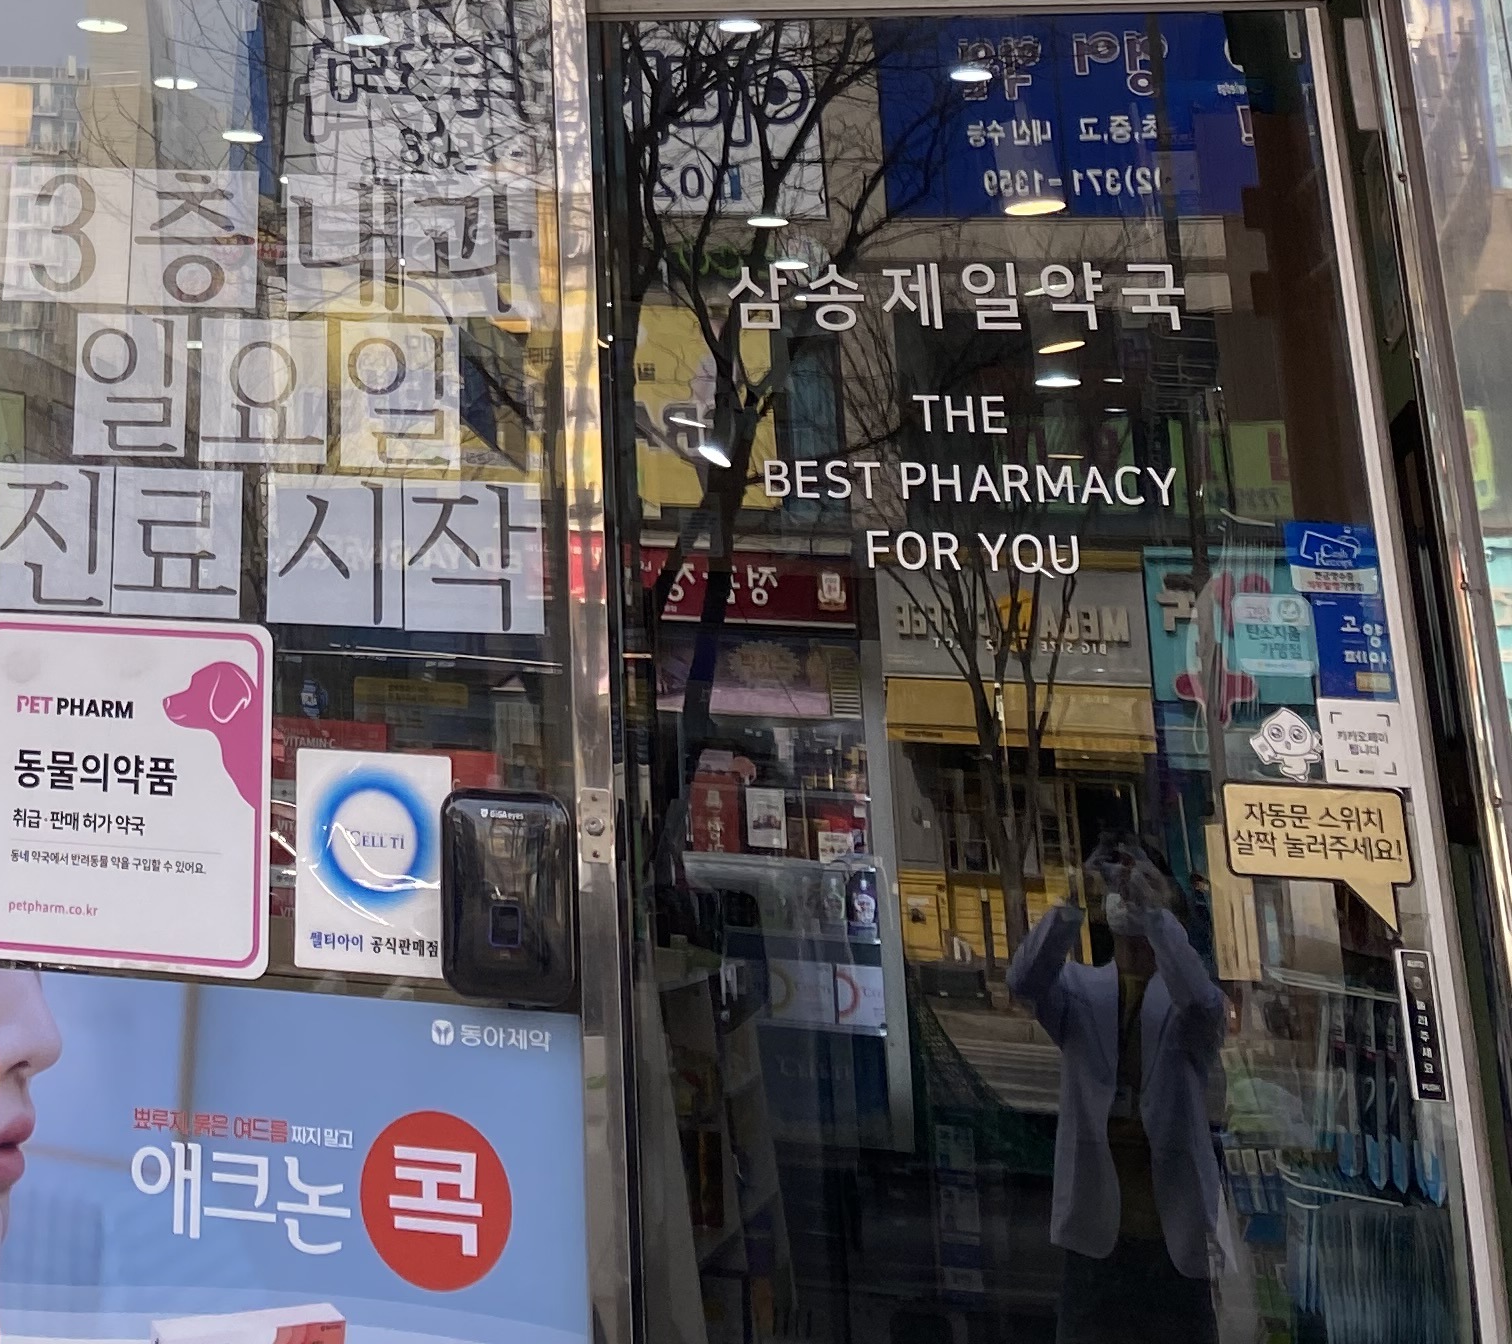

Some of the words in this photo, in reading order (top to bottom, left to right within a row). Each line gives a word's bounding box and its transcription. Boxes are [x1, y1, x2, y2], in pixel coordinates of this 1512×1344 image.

[29, 173, 255, 303] 3층
[290, 174, 534, 314] 내과
[728, 262, 1185, 332] 삼송제일약국
[81, 315, 445, 467] 일요일
[913, 394, 1007, 435] THE
[763, 460, 881, 502] BEST
[901, 462, 1178, 508] PHARMACY
[0, 468, 237, 606] 진료
[278, 480, 539, 633] 시작
[866, 530, 962, 572] FOR
[979, 533, 1081, 576] YOU
[1340, 615, 1384, 648] 고양
[17, 695, 53, 715] PET
[56, 697, 134, 719] PHARM
[14, 749, 178, 796] 동물의약품
[82, 812, 113, 834] 허가
[115, 814, 146, 837] 약국
[1244, 801, 1310, 830] 자동문
[1318, 806, 1385, 834] 스위치
[10, 849, 30, 863] 동네
[31, 850, 69, 866] 약국에서
[71, 853, 109, 869] 반려동물
[110, 856, 130, 870] 약을
[131, 857, 161, 872] 구입할
[163, 860, 174, 873] 수
[1233, 829, 1278, 857] 살짝
[1283, 832, 1403, 863] 눌러주세요!
[8, 900, 98, 917] petpharm.co.kr
[370, 936, 438, 957] 공식판매점
[461, 1024, 551, 1052] 동아제약
[233, 1117, 288, 1143] 여드름
[324, 1129, 354, 1149] 말고
[131, 1140, 351, 1255] 애크논
[389, 1145, 484, 1258] 콕
